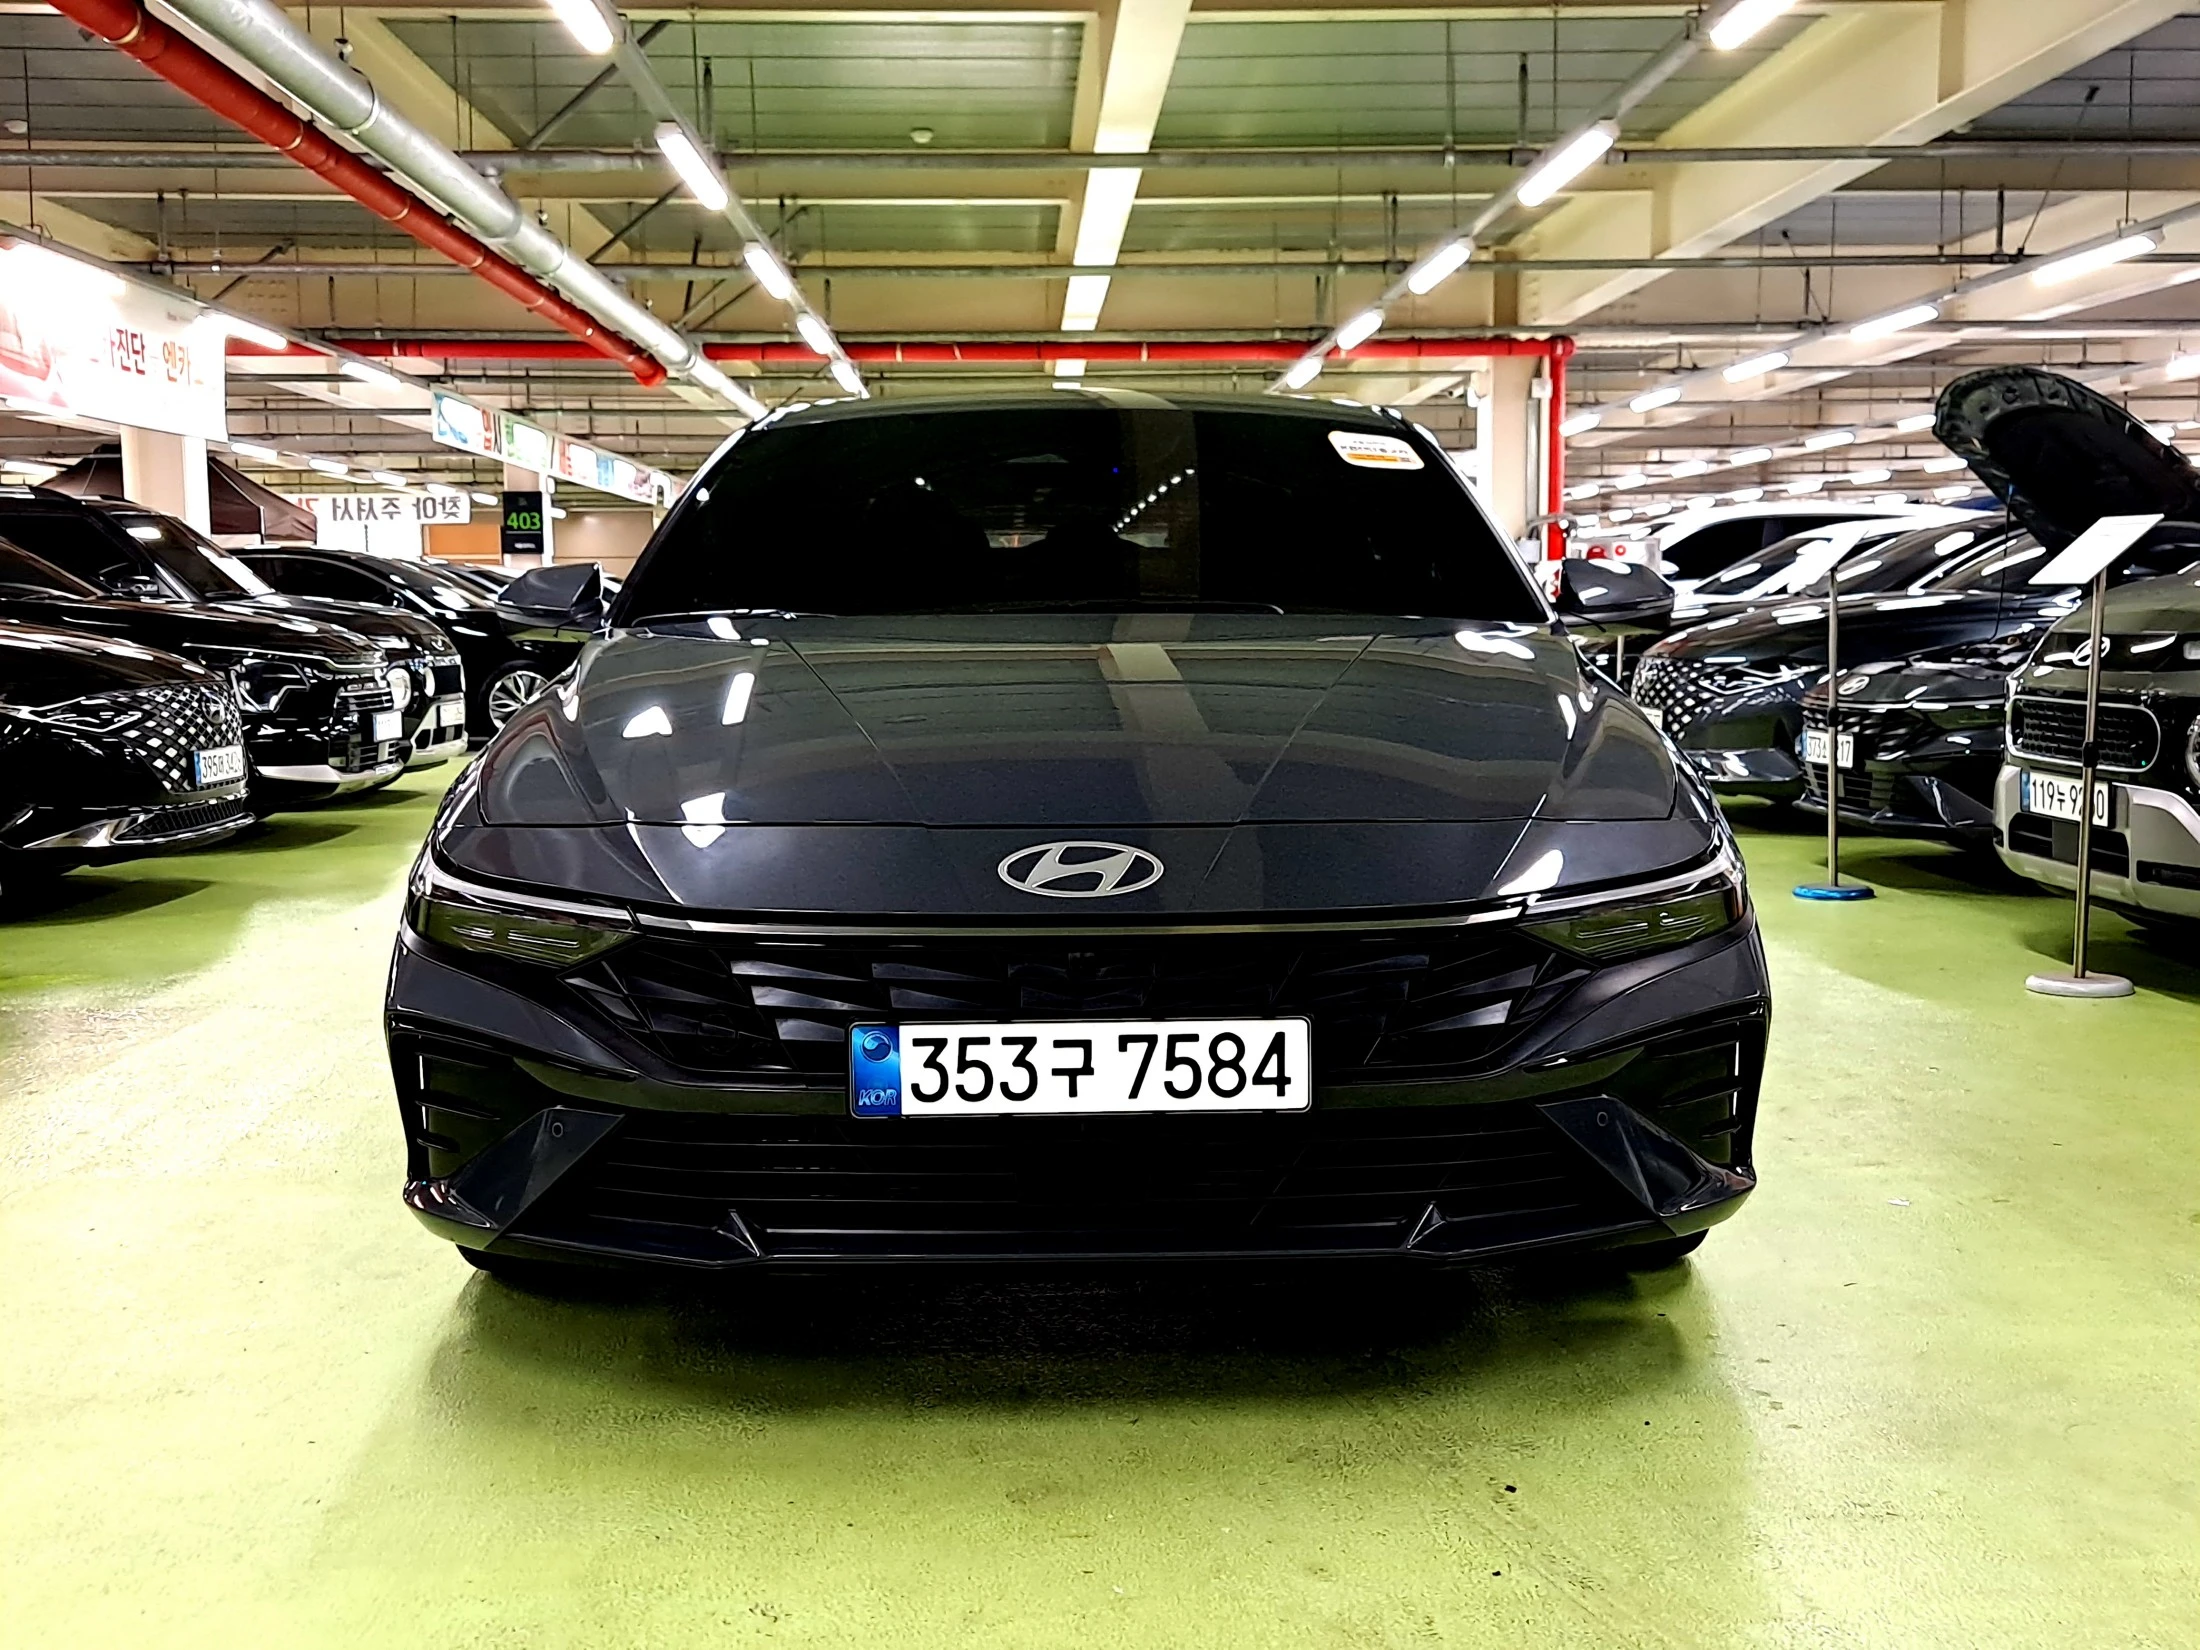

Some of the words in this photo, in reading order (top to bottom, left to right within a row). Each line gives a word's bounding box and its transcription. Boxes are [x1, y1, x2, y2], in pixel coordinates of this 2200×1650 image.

[507, 512, 541, 530] 403
[2032, 778, 2066, 812] 119누
[911, 1036, 1095, 1102] 353구
[1118, 1031, 1292, 1099] 7584
[858, 1088, 898, 1106] KOR
